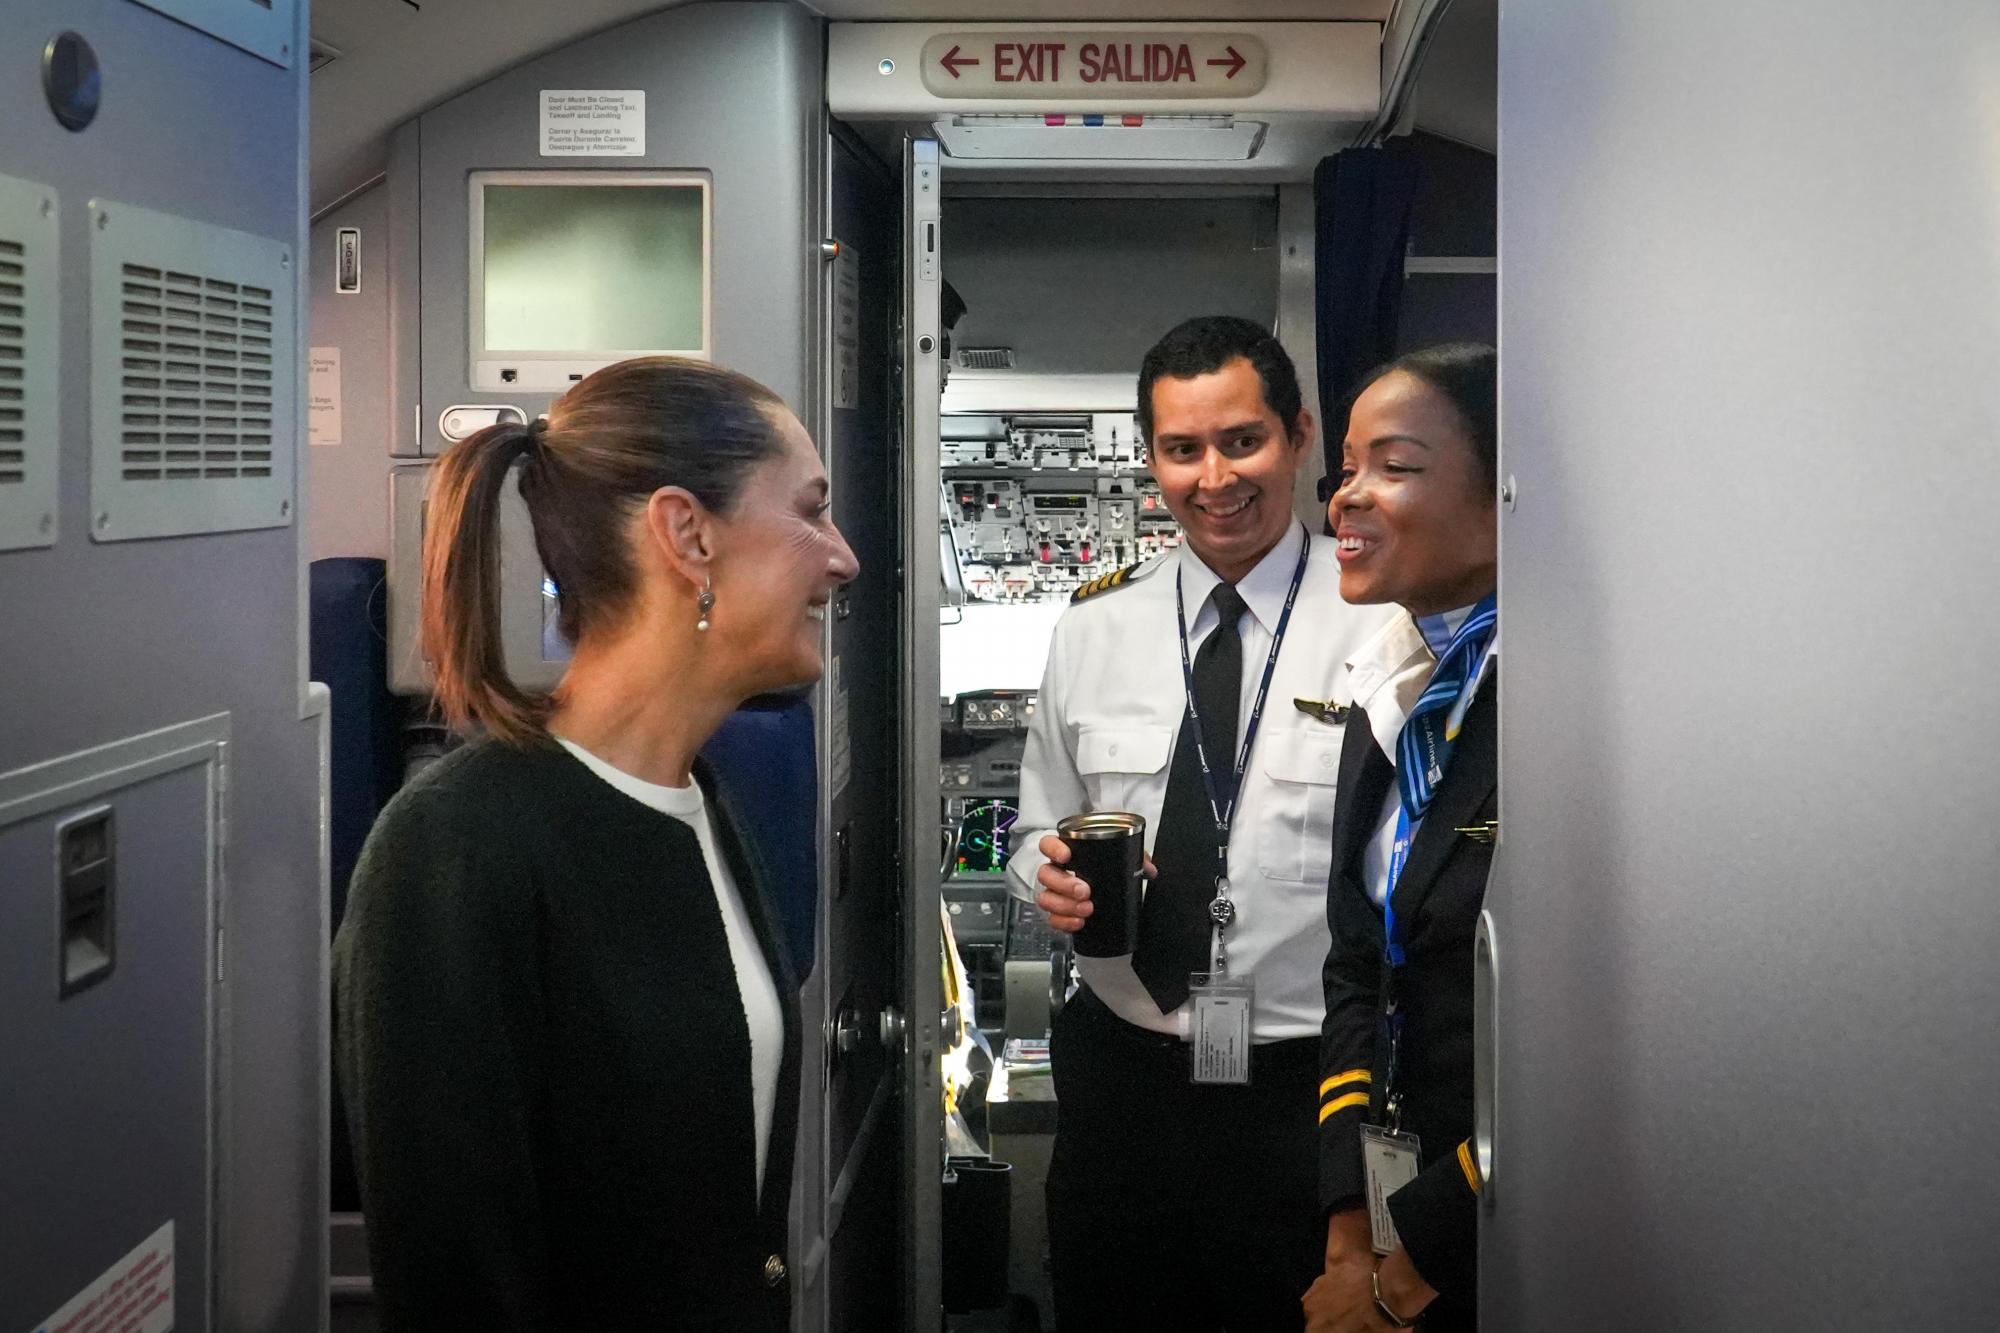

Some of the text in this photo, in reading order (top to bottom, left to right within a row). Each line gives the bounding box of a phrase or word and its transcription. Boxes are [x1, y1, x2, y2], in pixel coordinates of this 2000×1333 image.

[994, 43, 1196, 83] EXIT SALIDA
[594, 104, 619, 112] During
[592, 112, 622, 120] Landing
[580, 128, 612, 136] Asegurar
[1426, 730, 1436, 768] Airlines
